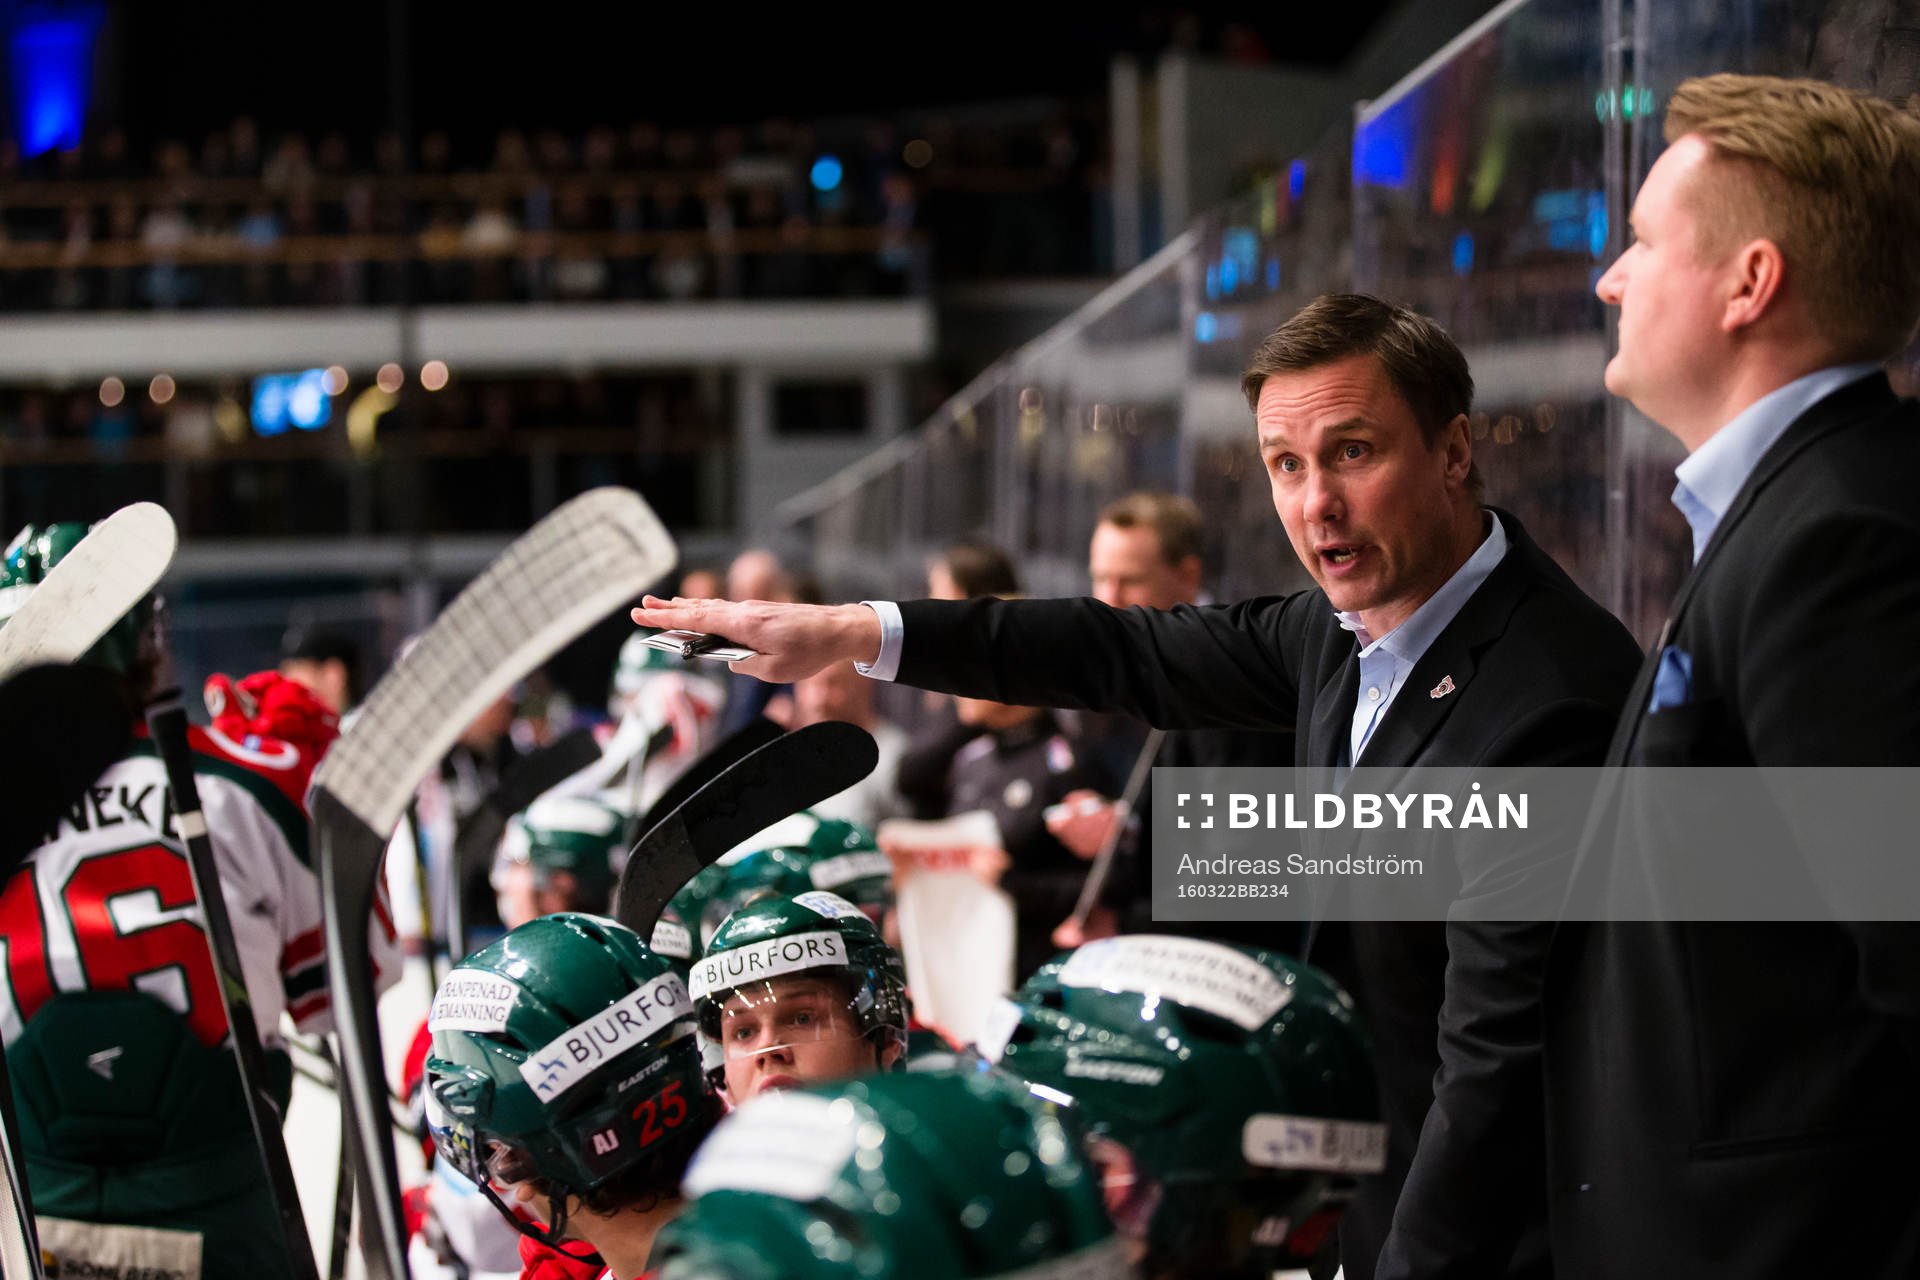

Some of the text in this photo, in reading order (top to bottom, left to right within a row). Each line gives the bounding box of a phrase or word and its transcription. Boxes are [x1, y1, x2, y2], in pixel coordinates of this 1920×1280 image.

[706, 936, 837, 985] BJURFORS
[617, 1055, 670, 1093] EASTON
[631, 1079, 688, 1148] 25
